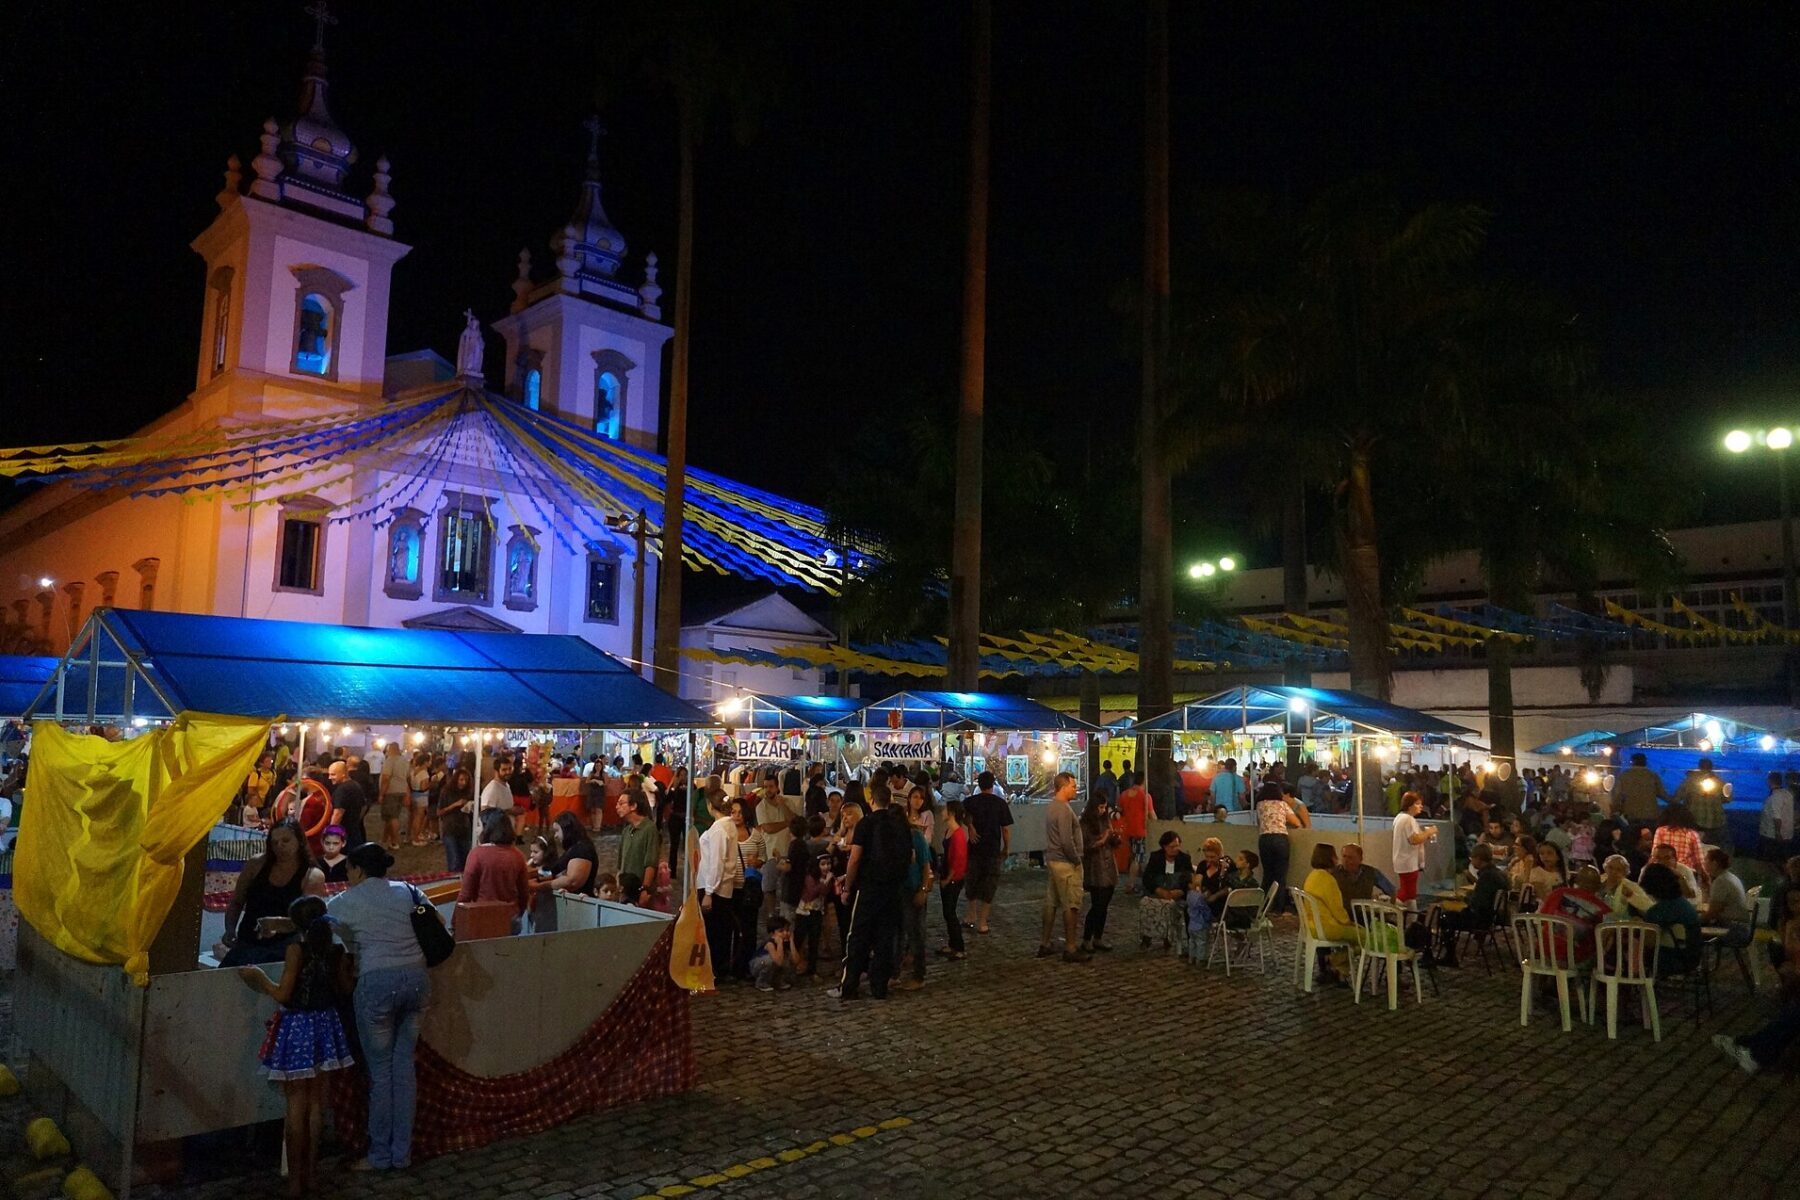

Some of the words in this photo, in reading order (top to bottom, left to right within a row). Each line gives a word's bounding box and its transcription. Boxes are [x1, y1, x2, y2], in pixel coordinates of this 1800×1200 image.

[739, 741, 790, 758] BAZAR
[874, 741, 932, 758] SANTARIA
[689, 944, 706, 967] H
